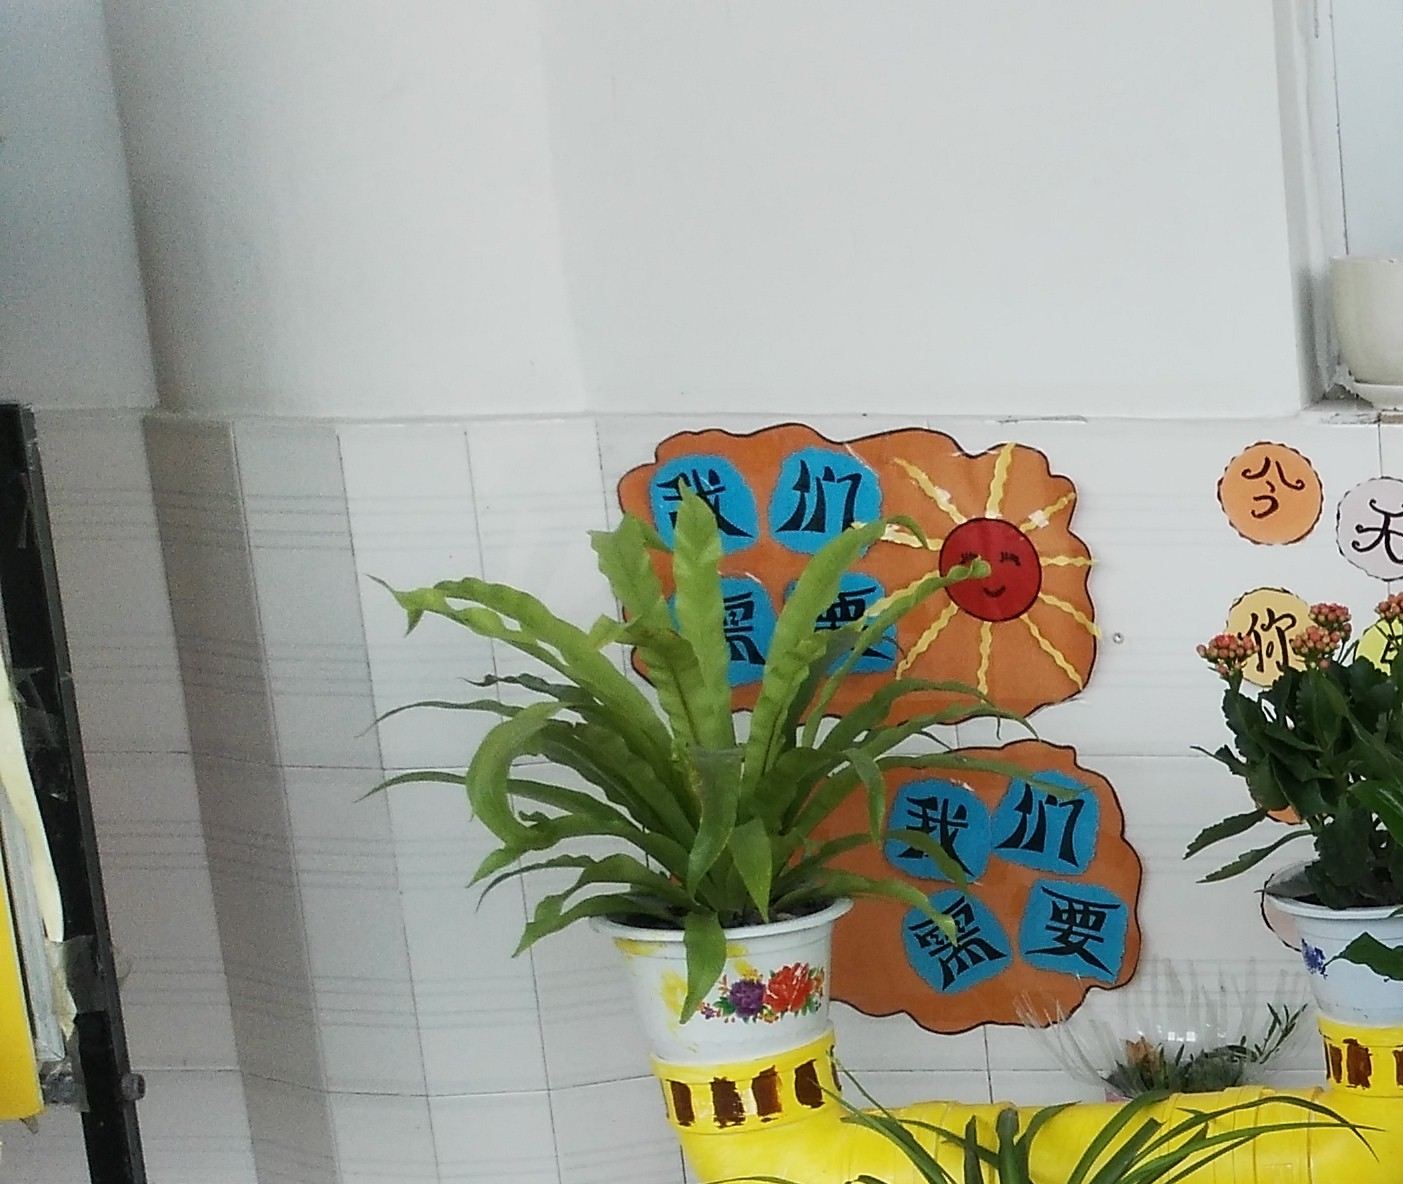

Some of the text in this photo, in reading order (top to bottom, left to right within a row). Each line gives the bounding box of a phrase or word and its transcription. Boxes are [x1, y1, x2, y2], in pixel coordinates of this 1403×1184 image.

[1241, 456, 1305, 519] 今
[897, 783, 1086, 877] 我们
[908, 886, 1121, 991] 需要
